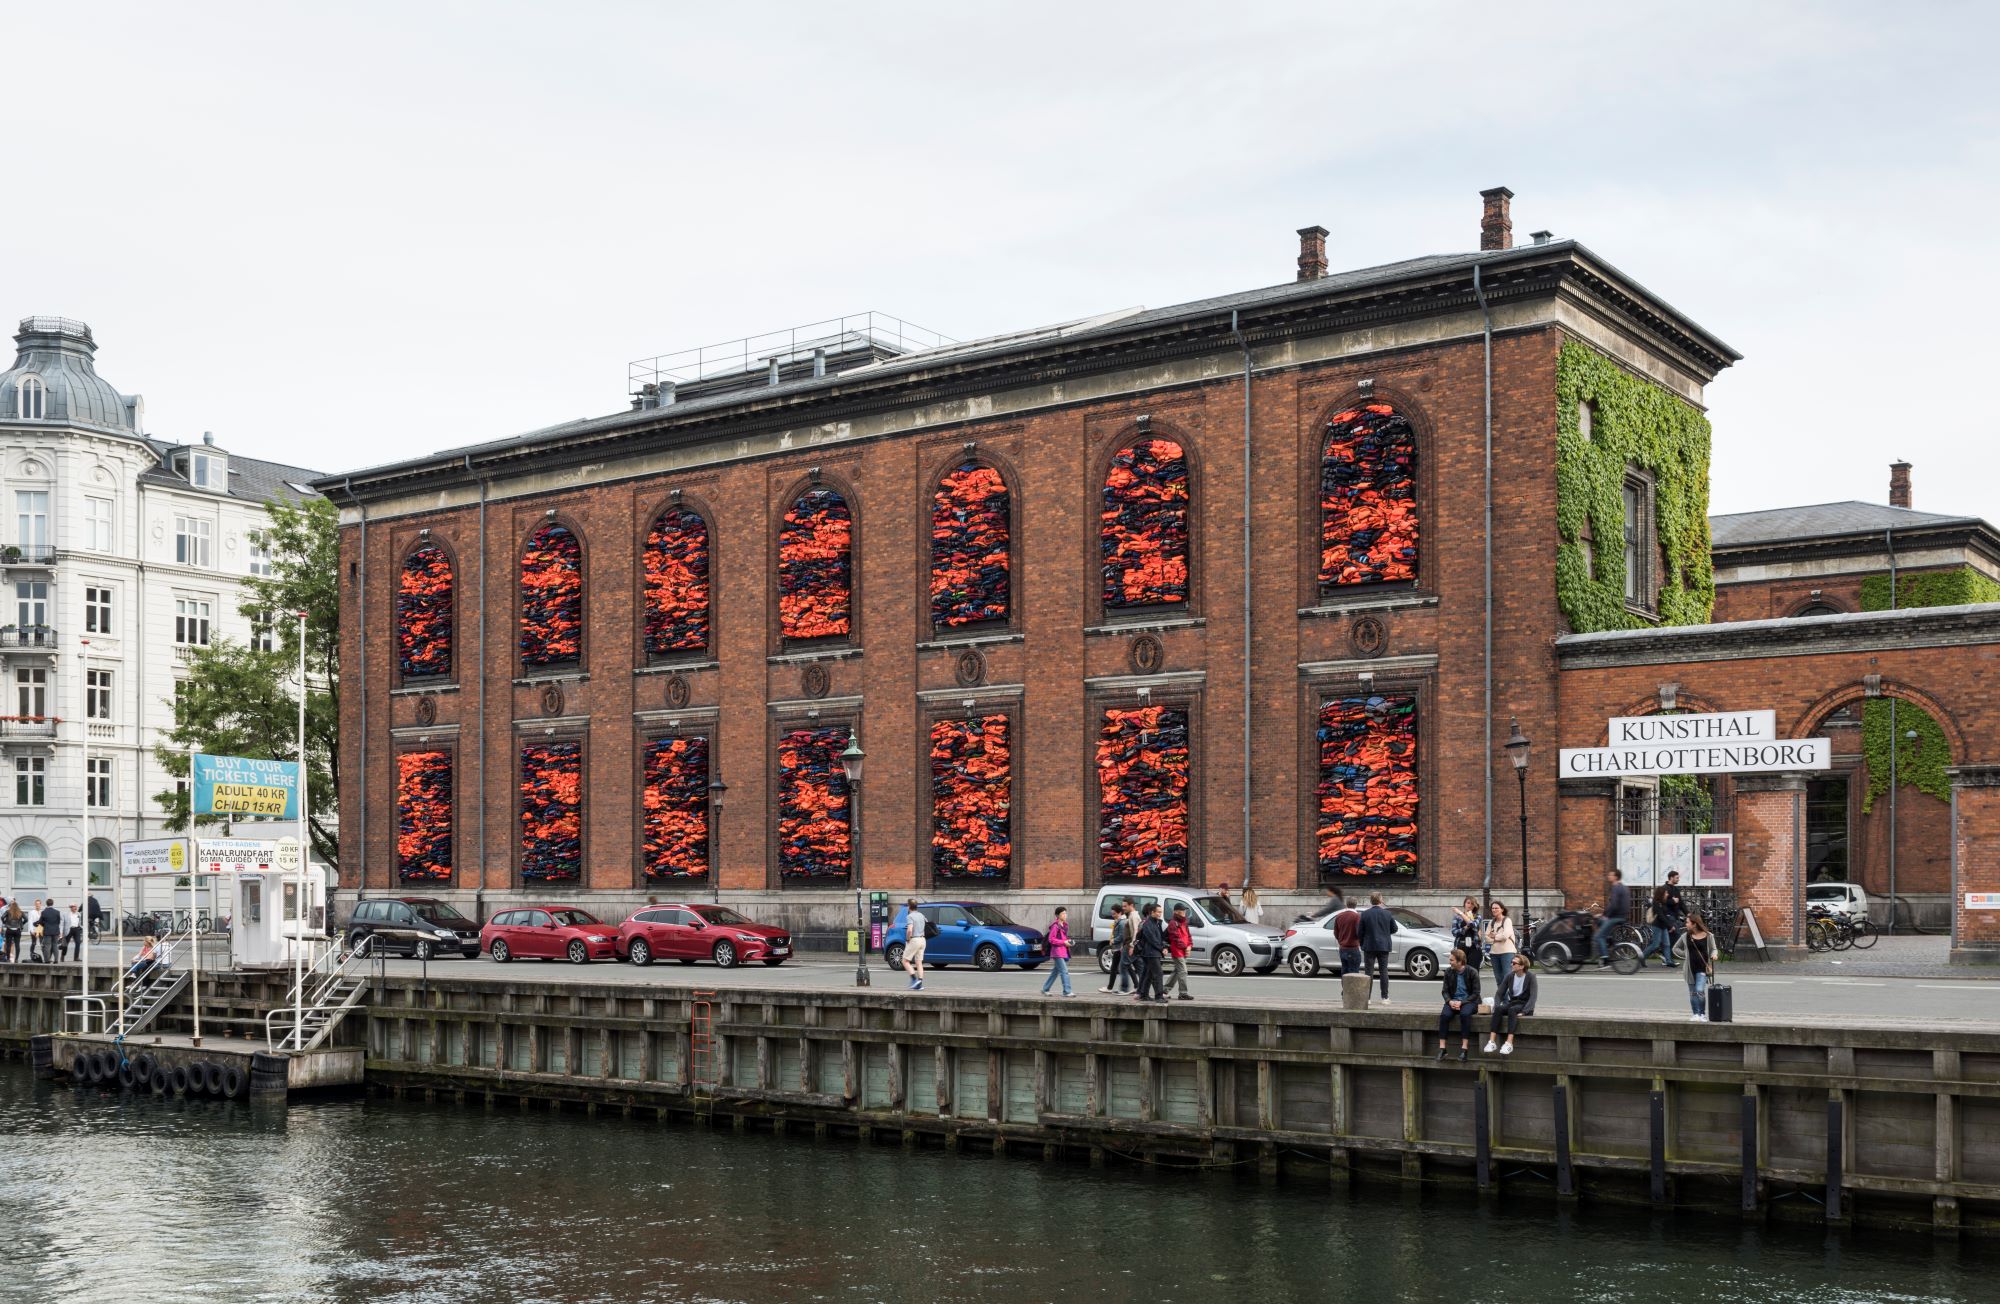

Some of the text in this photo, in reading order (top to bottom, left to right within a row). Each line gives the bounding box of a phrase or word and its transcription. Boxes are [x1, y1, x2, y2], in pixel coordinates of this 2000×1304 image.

[1622, 716, 1760, 741] KUNSTHAL
[215, 757, 283, 773] BUY YOUR
[1570, 744, 1815, 772] CHARLOTTENBORG
[203, 768, 295, 786] TICKETS HERE
[215, 786, 285, 800] ADULT 40 KR
[215, 799, 281, 813] CHILD 15 KR
[158, 856, 169, 864] TOUR
[200, 848, 274, 857] KANALRUNDFART
